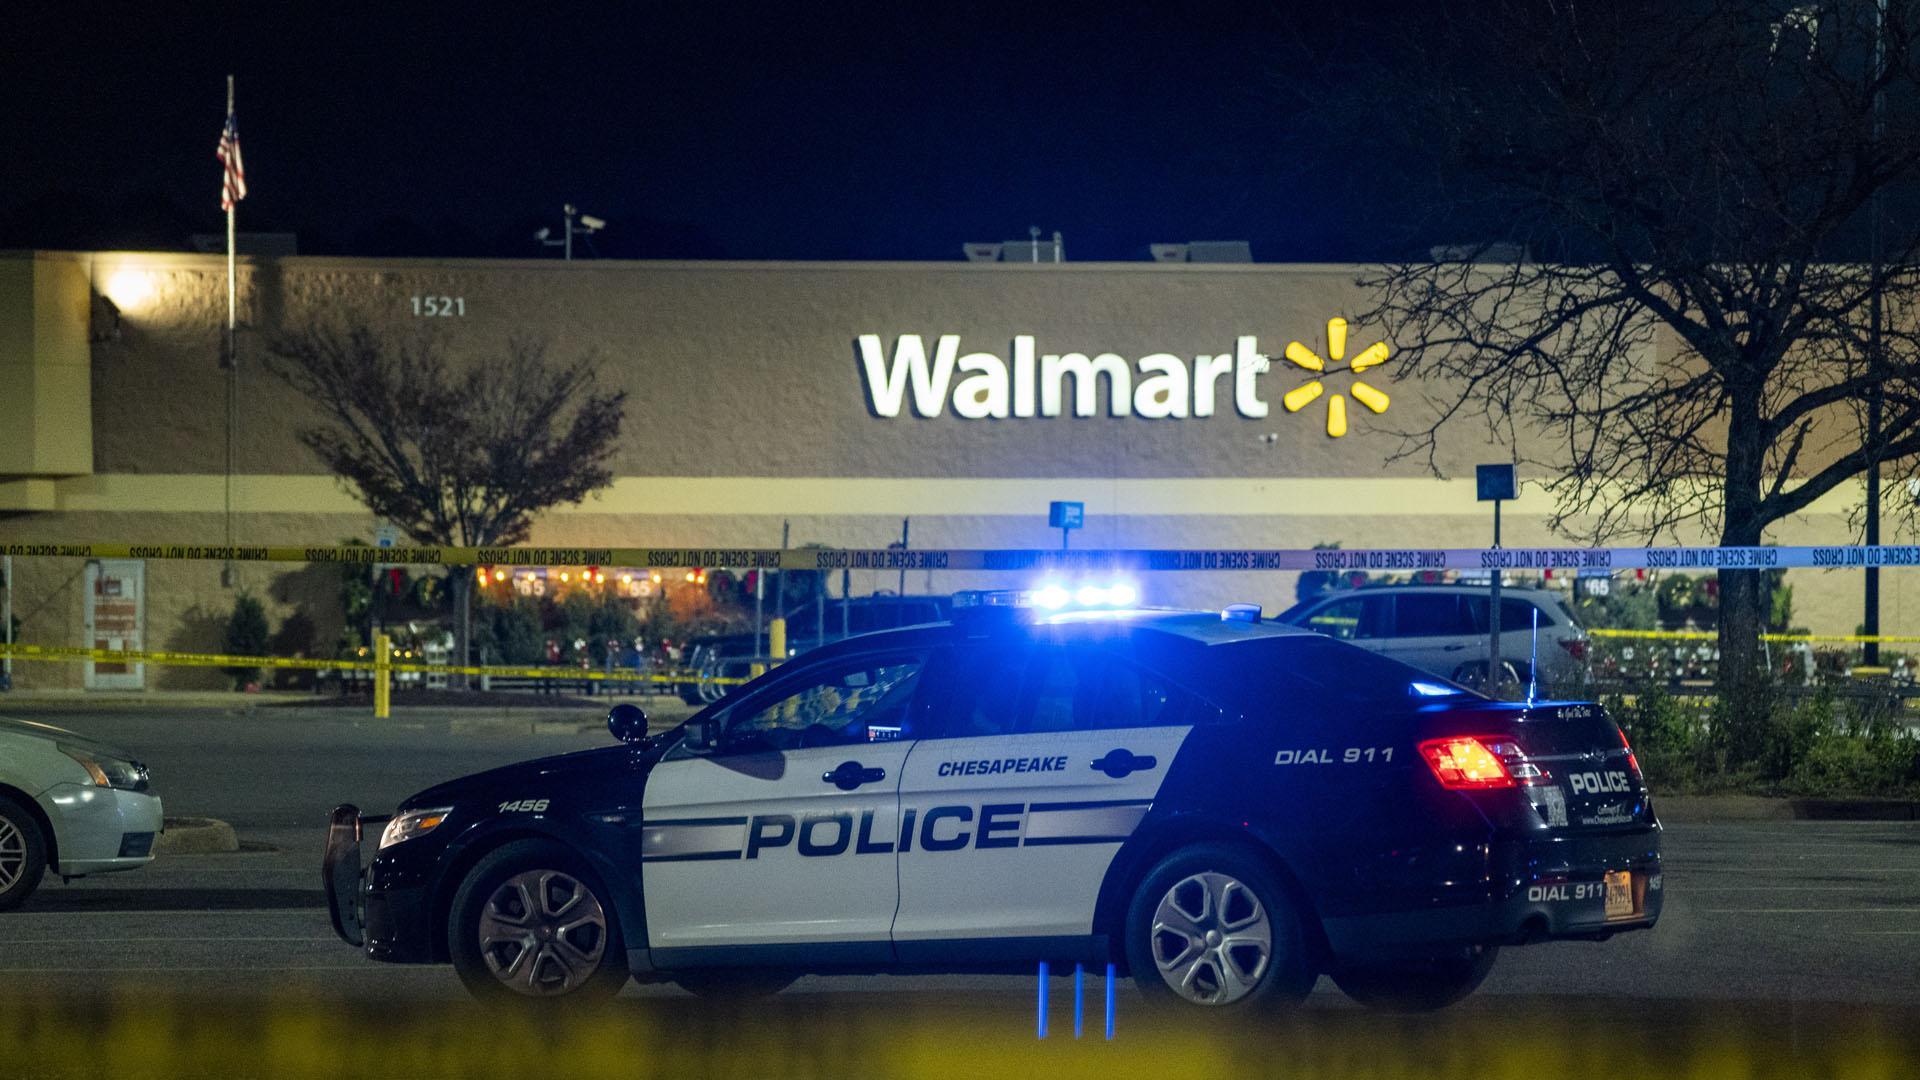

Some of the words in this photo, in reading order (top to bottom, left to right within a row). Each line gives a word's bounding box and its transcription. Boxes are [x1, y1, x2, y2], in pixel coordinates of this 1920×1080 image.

[410, 297, 465, 317] 1521
[858, 334, 1269, 418] Walmart
[477, 550, 509, 564] CROSS
[513, 550, 530, 564] NOT
[534, 550, 547, 564] DO
[549, 550, 578, 565] SCENE
[582, 550, 611, 565] CRIME
[648, 551, 679, 567] CROSS
[682, 551, 701, 567] NOT
[703, 551, 717, 567] DO
[719, 551, 748, 567] SCENE
[752, 551, 781, 567] CRIME
[816, 552, 848, 568] CROSS
[850, 552, 869, 568] NOT
[872, 552, 885, 568] DO
[887, 552, 917, 568] SCENE
[919, 552, 948, 568] CRIME
[1184, 552, 1202, 568] NOT
[1204, 552, 1217, 568] DO
[1220, 552, 1249, 568] SCENE
[1252, 552, 1280, 568] CRIME
[1315, 552, 1346, 568] CROSS
[1349, 552, 1367, 568] NOT
[1370, 552, 1382, 568] DO
[1386, 552, 1415, 568] SCENE
[1417, 552, 1446, 568] CRIME
[1481, 552, 1512, 568] CROSS
[1515, 552, 1532, 568] NOT
[1536, 552, 1549, 568] DO
[1551, 551, 1580, 567] SCENE
[1583, 551, 1611, 567] CRIME
[1647, 551, 1678, 567] CROSS
[1680, 550, 1698, 566] NOT
[1701, 550, 1714, 566] DO
[1717, 550, 1745, 566] SCENE
[1749, 549, 1777, 565] CRIME
[1813, 549, 1844, 565] CROSS
[1846, 549, 1864, 565] NOT
[1868, 548, 1880, 564] DO
[1883, 548, 1912, 564] SCENE
[1275, 749, 1333, 765] DIAL
[1343, 747, 1393, 763] 911
[938, 757, 1067, 777] CHESAPEAKE
[1569, 771, 1630, 795] POLICE
[498, 799, 550, 813] 1456
[746, 803, 1026, 860] POLICE
[1528, 886, 1570, 902] DIAL
[1575, 884, 1603, 899] 911
